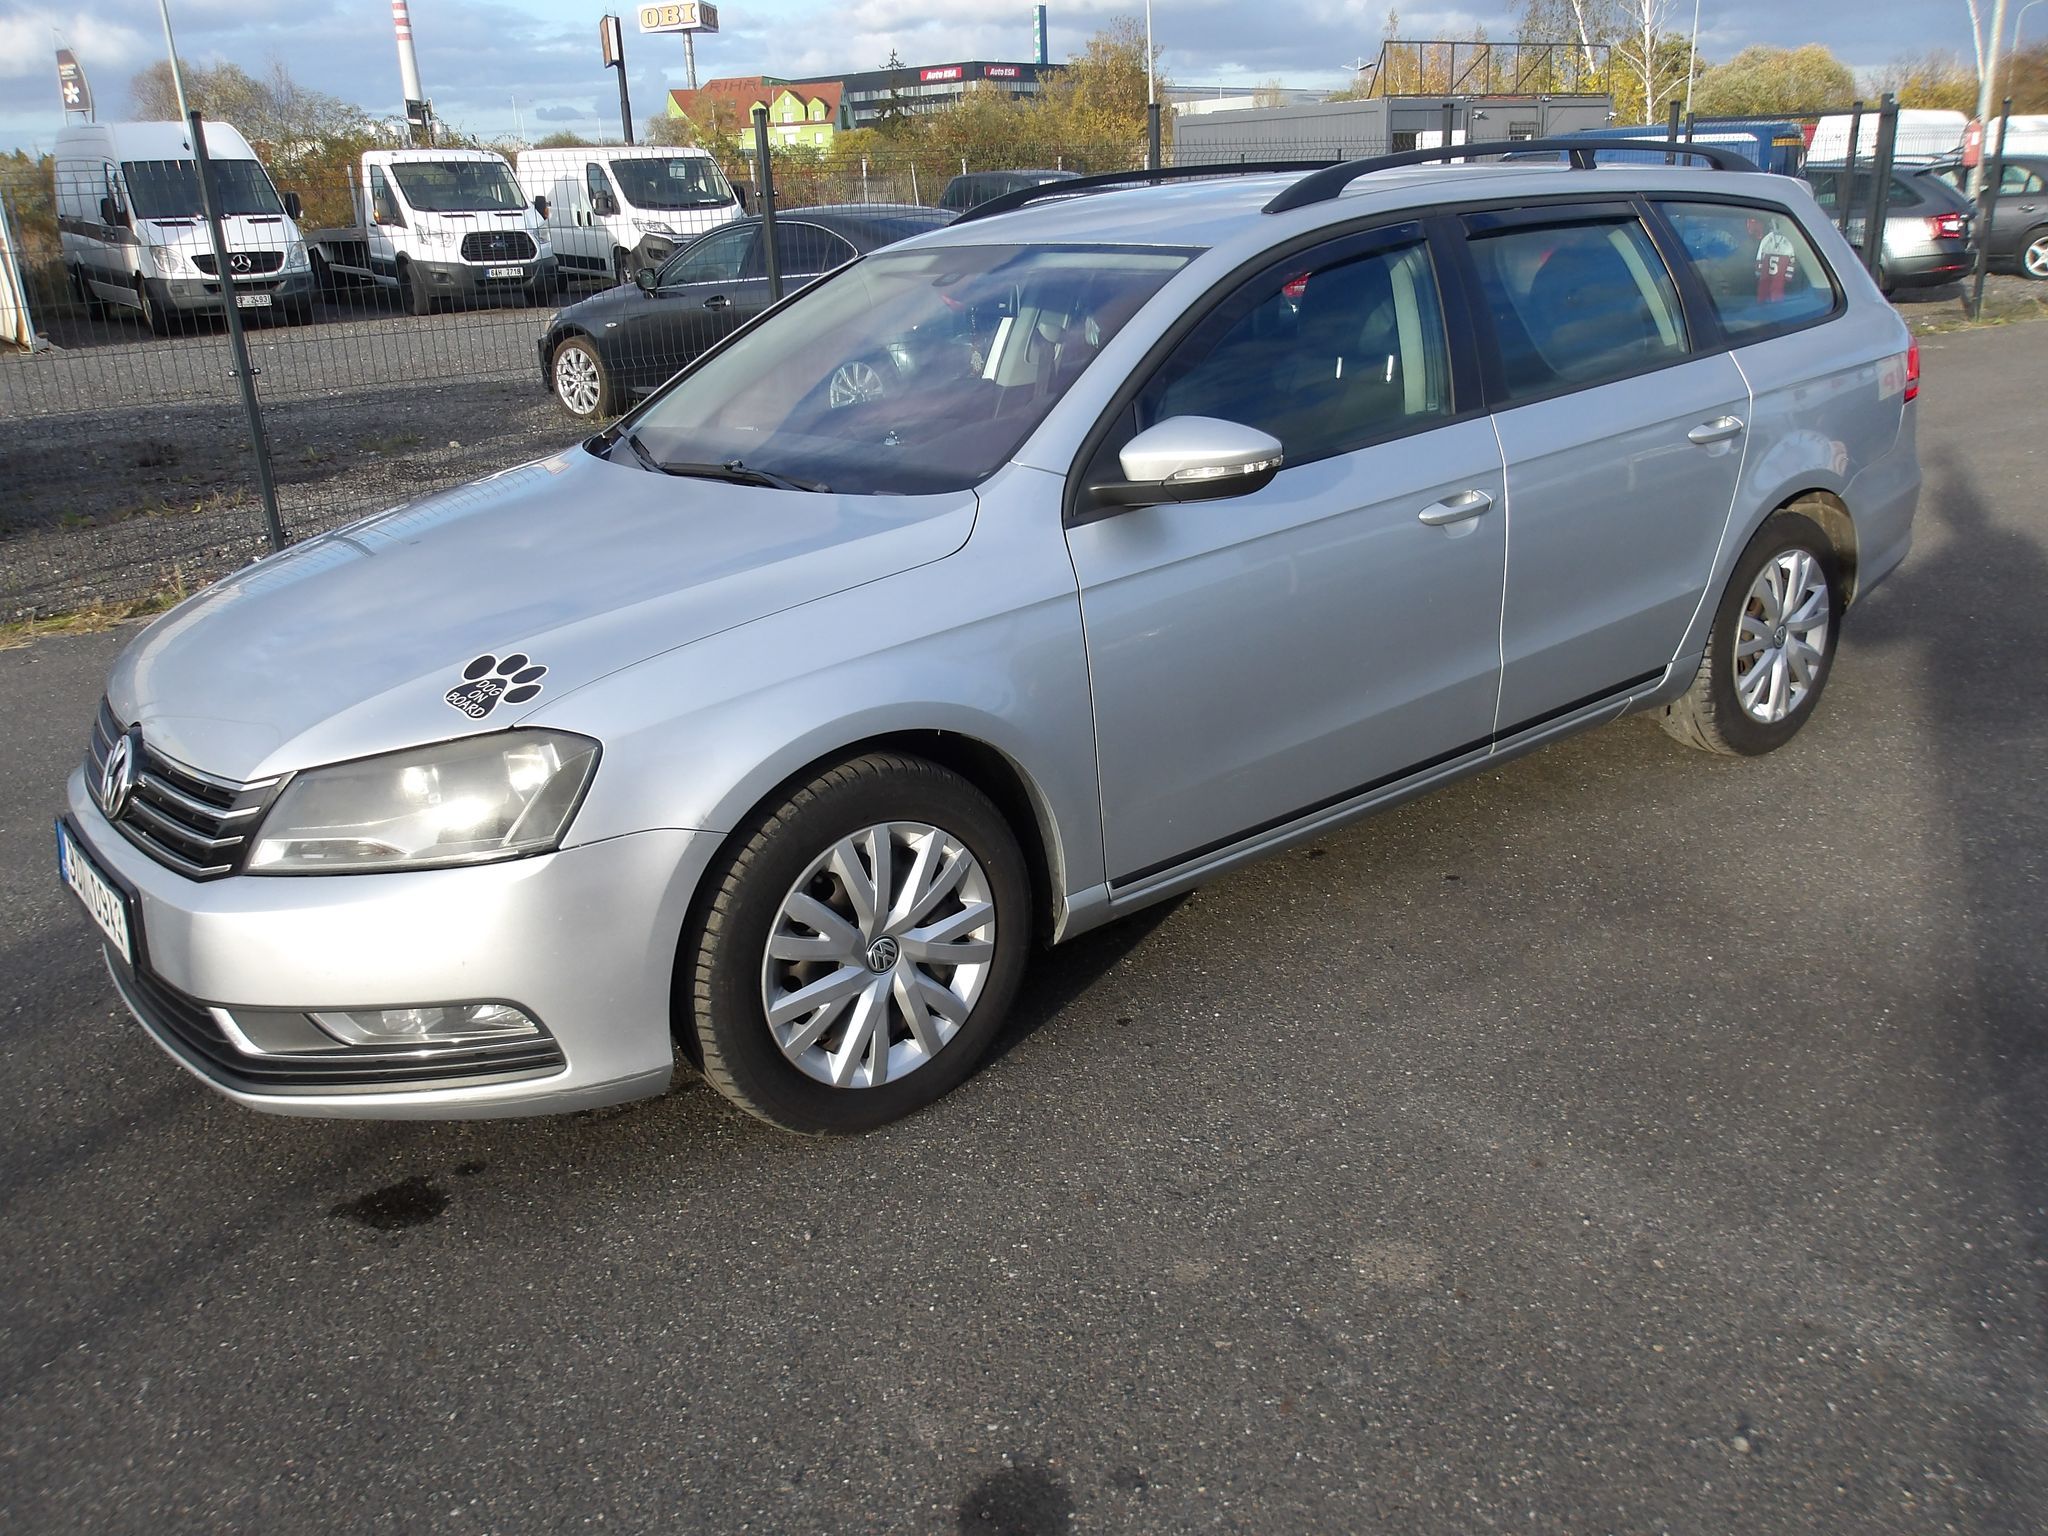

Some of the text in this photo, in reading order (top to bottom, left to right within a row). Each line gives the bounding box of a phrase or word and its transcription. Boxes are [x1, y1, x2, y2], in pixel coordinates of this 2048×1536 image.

[641, 3, 696, 28] OBI
[701, 4, 719, 28] OBI
[926, 70, 957, 80] Auto ESA
[990, 68, 1015, 76] Auto ESA
[1769, 256, 1779, 275] 5
[468, 690, 489, 703] ON
[476, 680, 503, 696] DOG
[446, 692, 485, 717] BOARD
